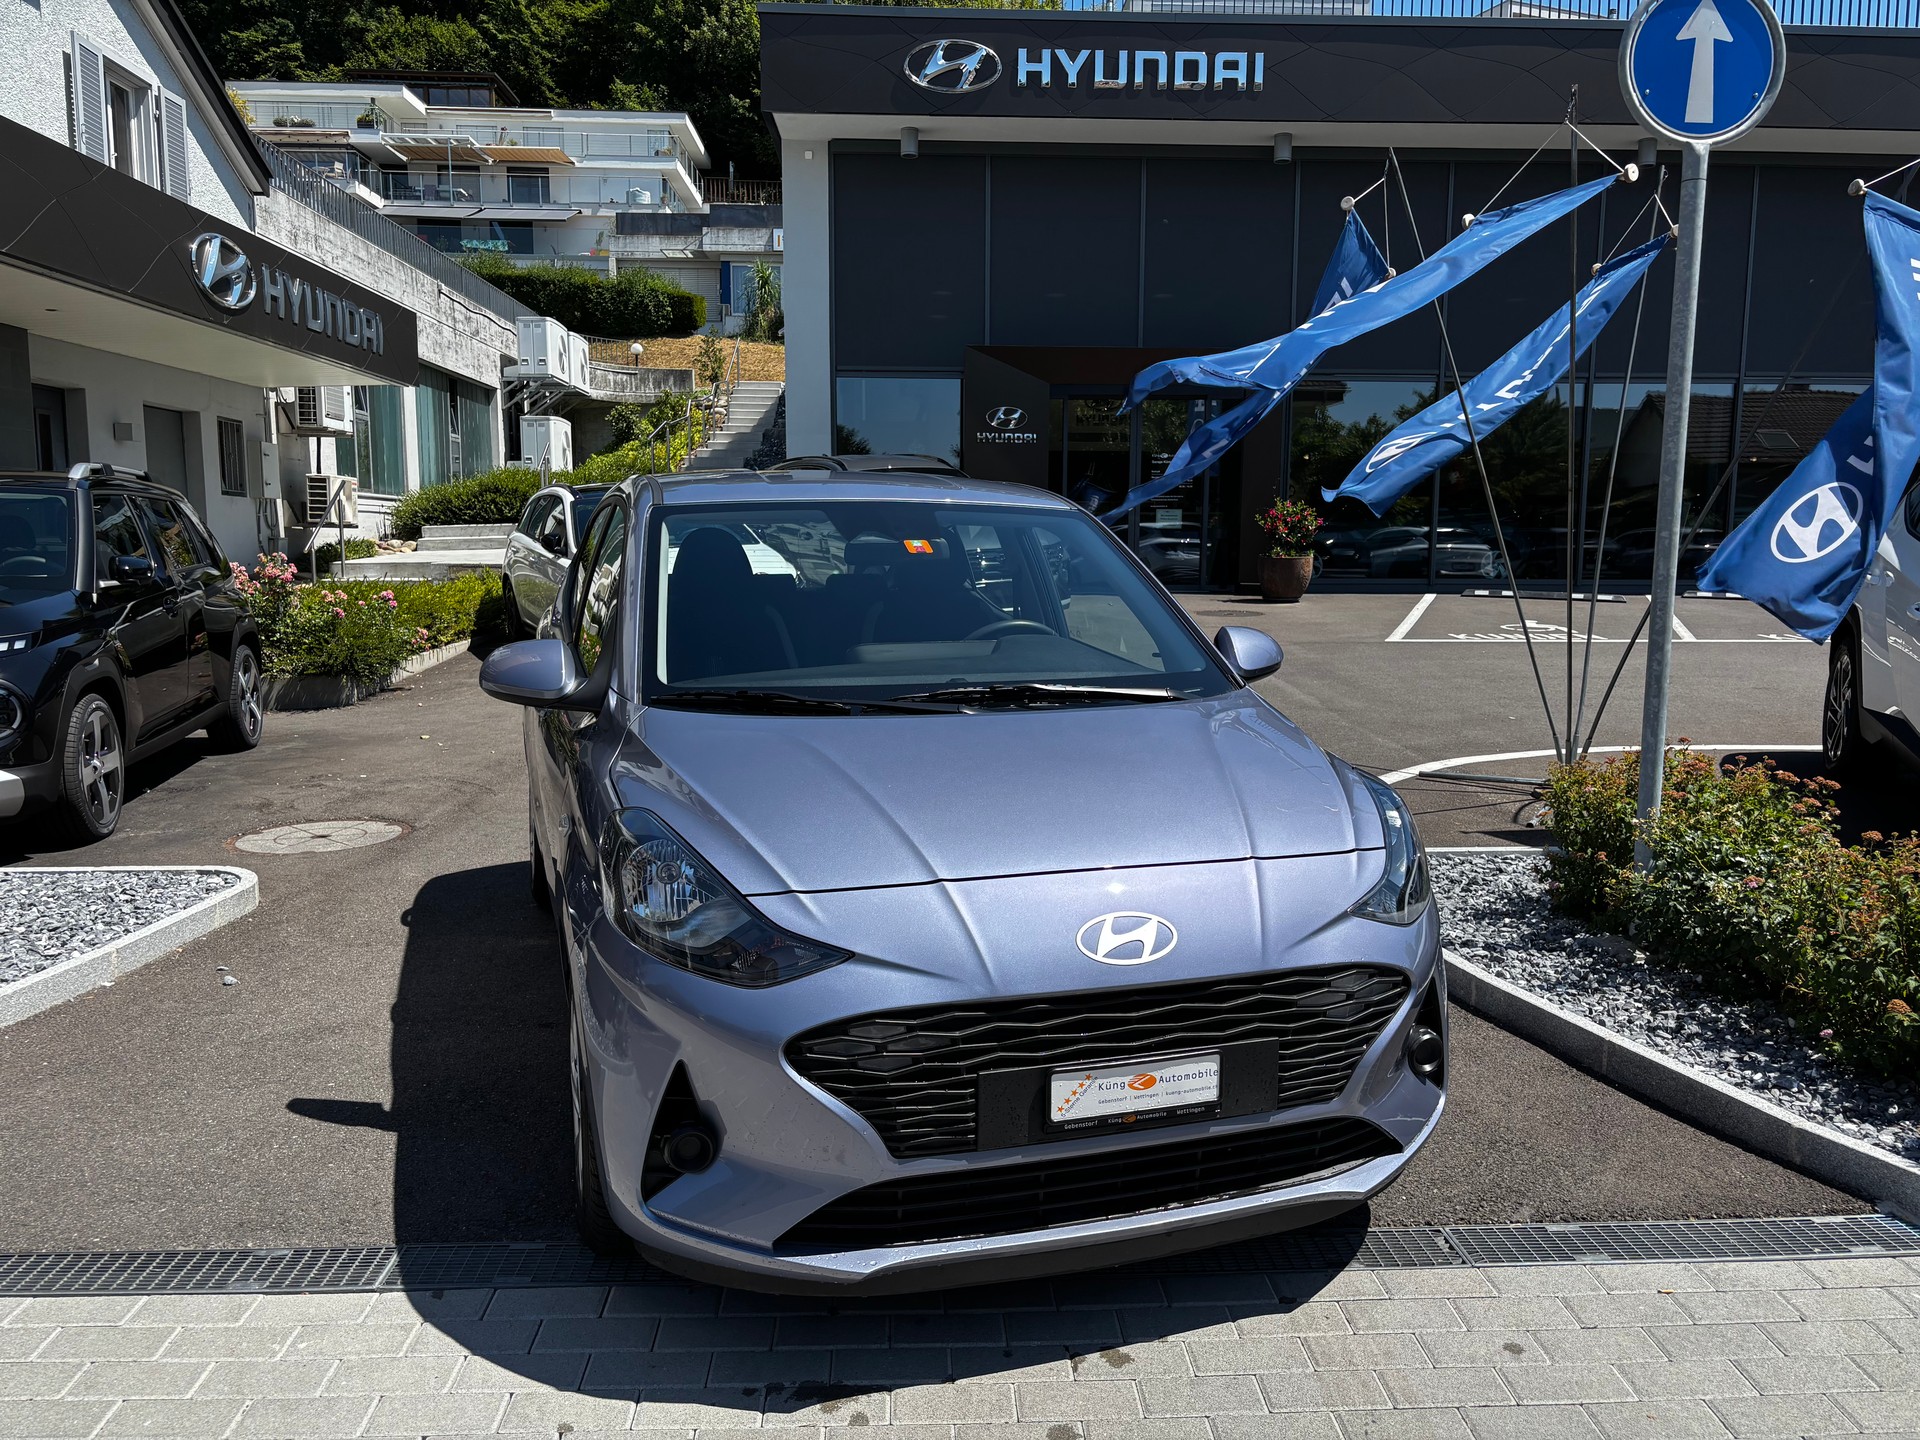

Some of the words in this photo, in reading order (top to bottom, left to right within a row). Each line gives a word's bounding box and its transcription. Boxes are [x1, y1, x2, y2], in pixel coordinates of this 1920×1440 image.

[1017, 47, 1265, 92] HYUNDAI
[261, 263, 384, 356] HYUNDAI
[976, 432, 1037, 443] HYUNDAI
[1098, 1081, 1126, 1091] Küng
[1158, 1068, 1219, 1084] Automobile
[1098, 1096, 1127, 1104] Gebenstorf
[1133, 1092, 1160, 1100] Wettingen
[1064, 1121, 1099, 1130] Gebenstorf
[1136, 1111, 1168, 1120] Automobile
[1177, 1107, 1206, 1115] Wettingen
